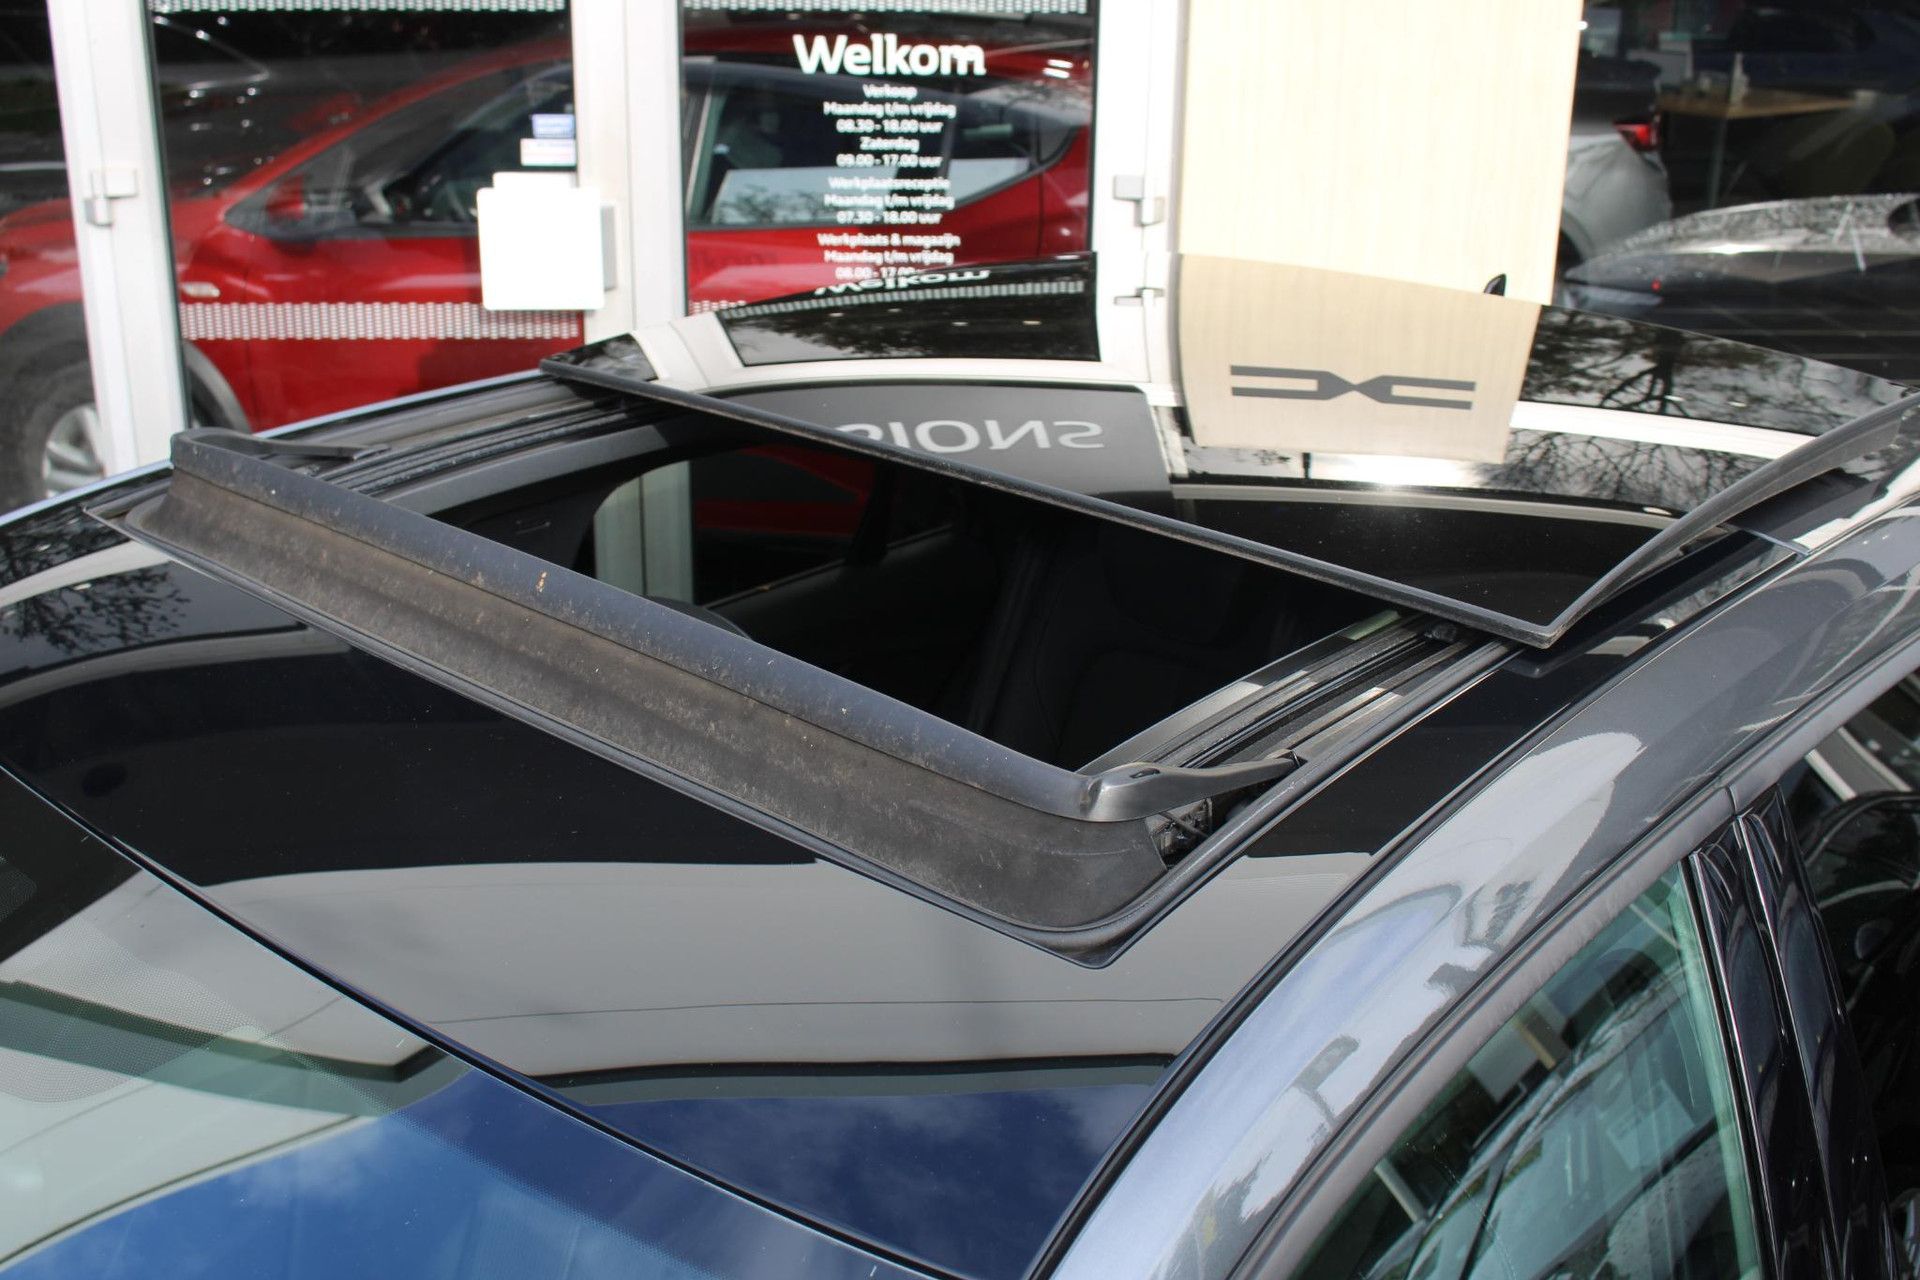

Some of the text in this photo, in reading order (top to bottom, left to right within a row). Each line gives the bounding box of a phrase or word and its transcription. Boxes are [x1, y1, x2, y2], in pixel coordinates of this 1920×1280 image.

[792, 33, 986, 76] Welkom
[823, 102, 884, 118] Maandag
[911, 102, 957, 119] vrijdag
[919, 121, 944, 133] uur
[860, 137, 920, 153] Zaterdag
[919, 156, 943, 168] uur
[918, 213, 943, 224] uur
[824, 250, 884, 266] Maandag
[909, 250, 955, 266] vrijdag
